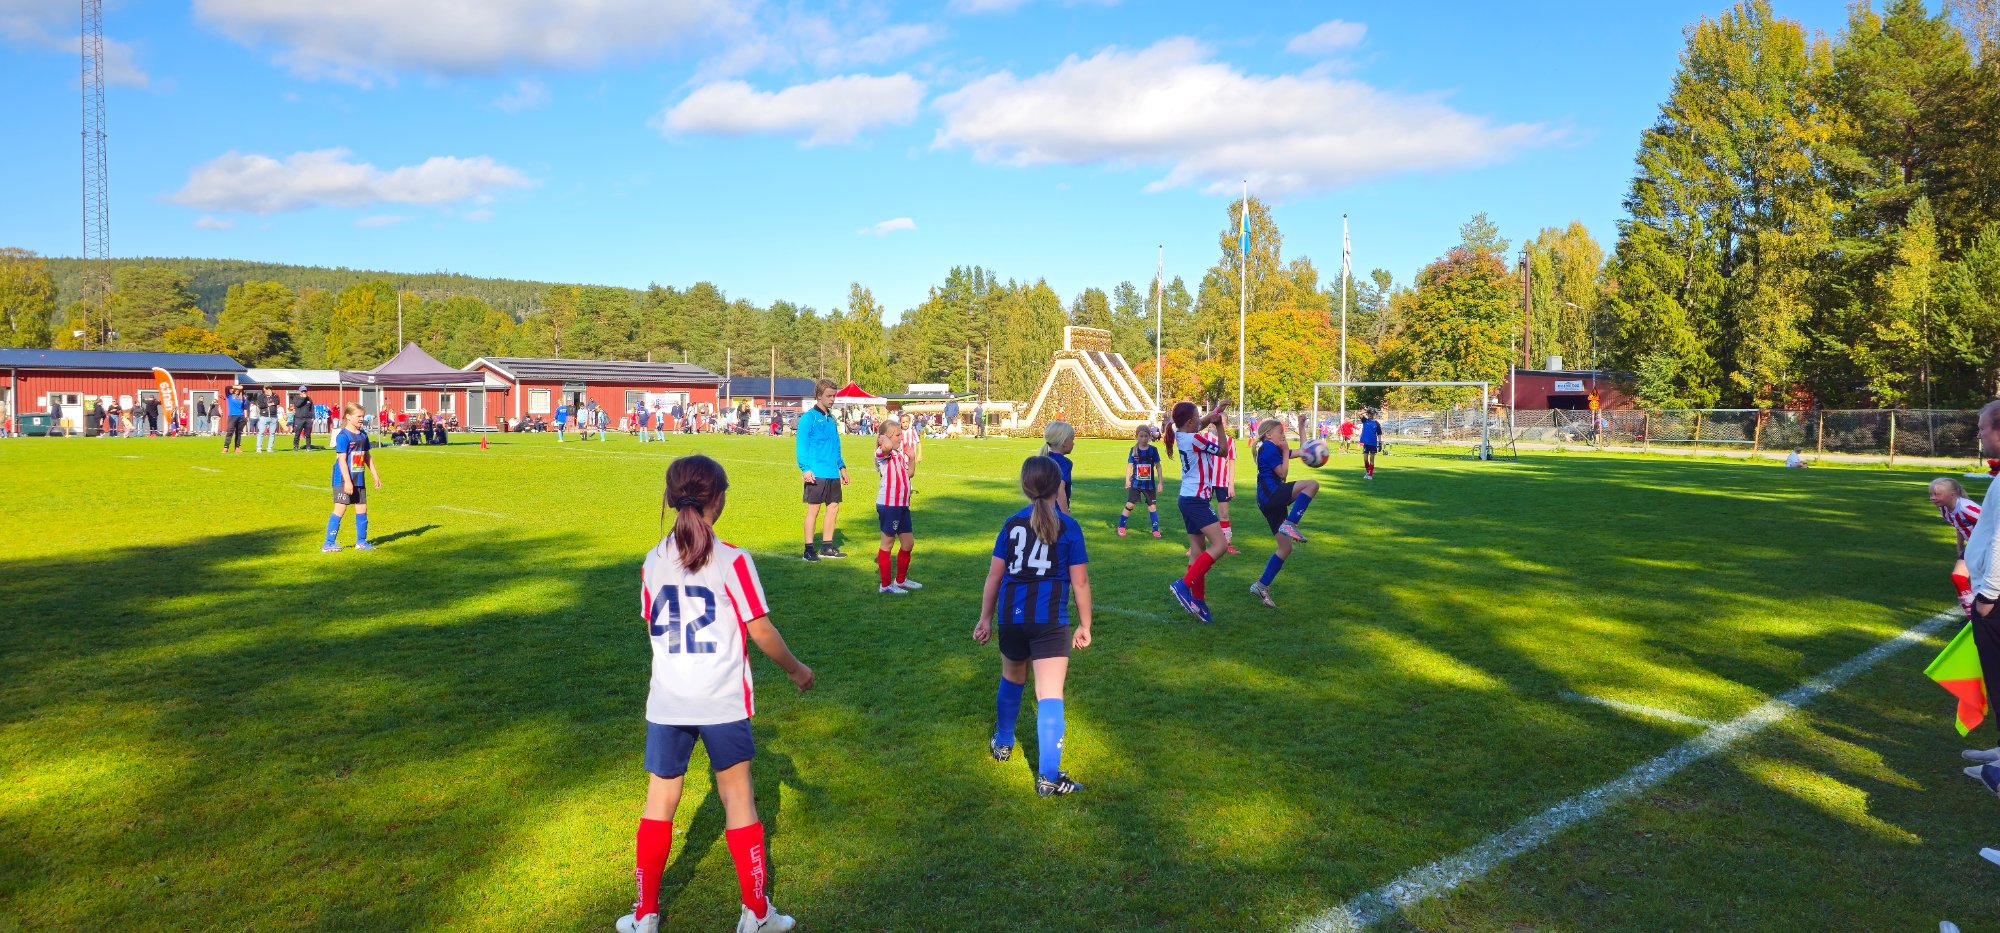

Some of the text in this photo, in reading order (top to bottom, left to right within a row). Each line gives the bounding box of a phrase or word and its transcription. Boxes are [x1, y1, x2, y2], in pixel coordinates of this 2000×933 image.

[1008, 525, 1051, 576] 34
[650, 584, 717, 654] 42
[750, 844, 764, 899] stadium
